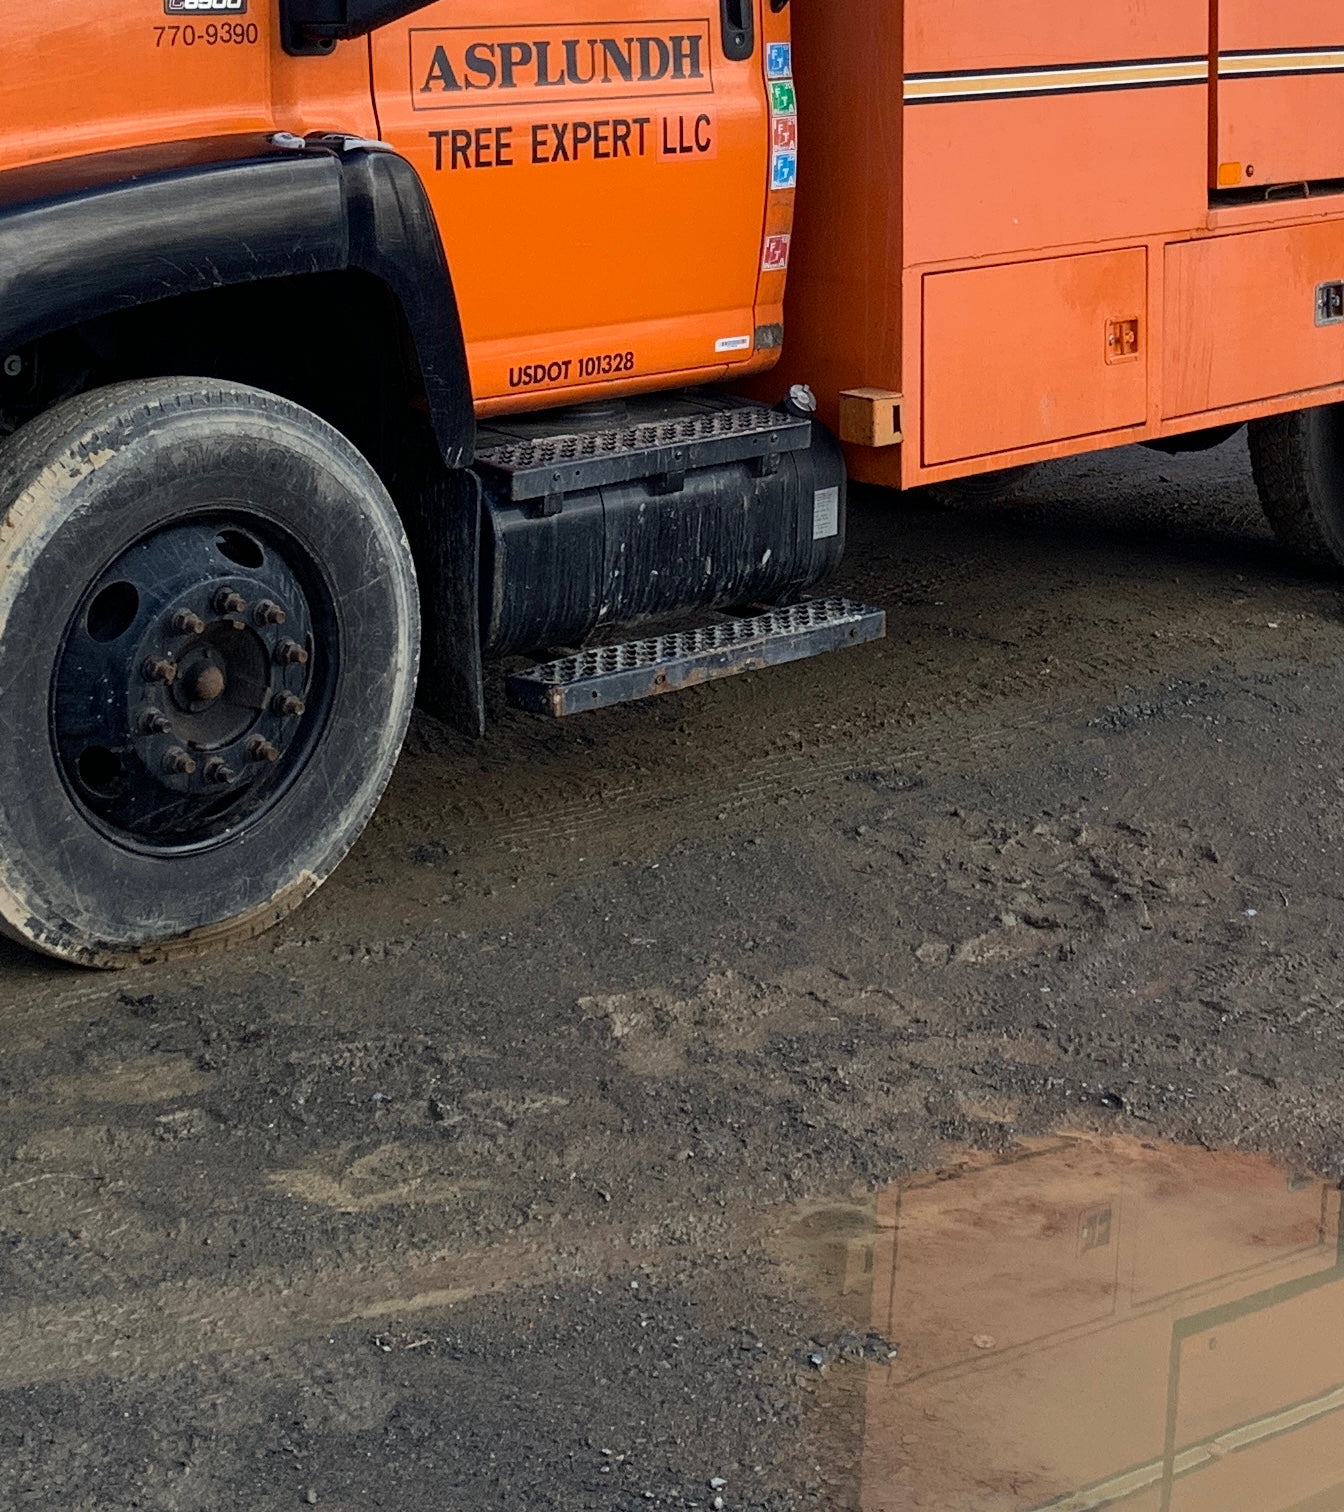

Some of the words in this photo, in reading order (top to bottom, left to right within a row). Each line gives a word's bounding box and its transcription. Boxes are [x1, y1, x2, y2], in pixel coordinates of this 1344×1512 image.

[153, 22, 258, 47] 770-9390
[420, 35, 704, 92] ASPLUNDH
[428, 126, 514, 171] TREE
[531, 117, 651, 164] EXPERT
[662, 113, 711, 154] LLC
[509, 360, 572, 387] USDOT
[578, 352, 634, 377] 101328
